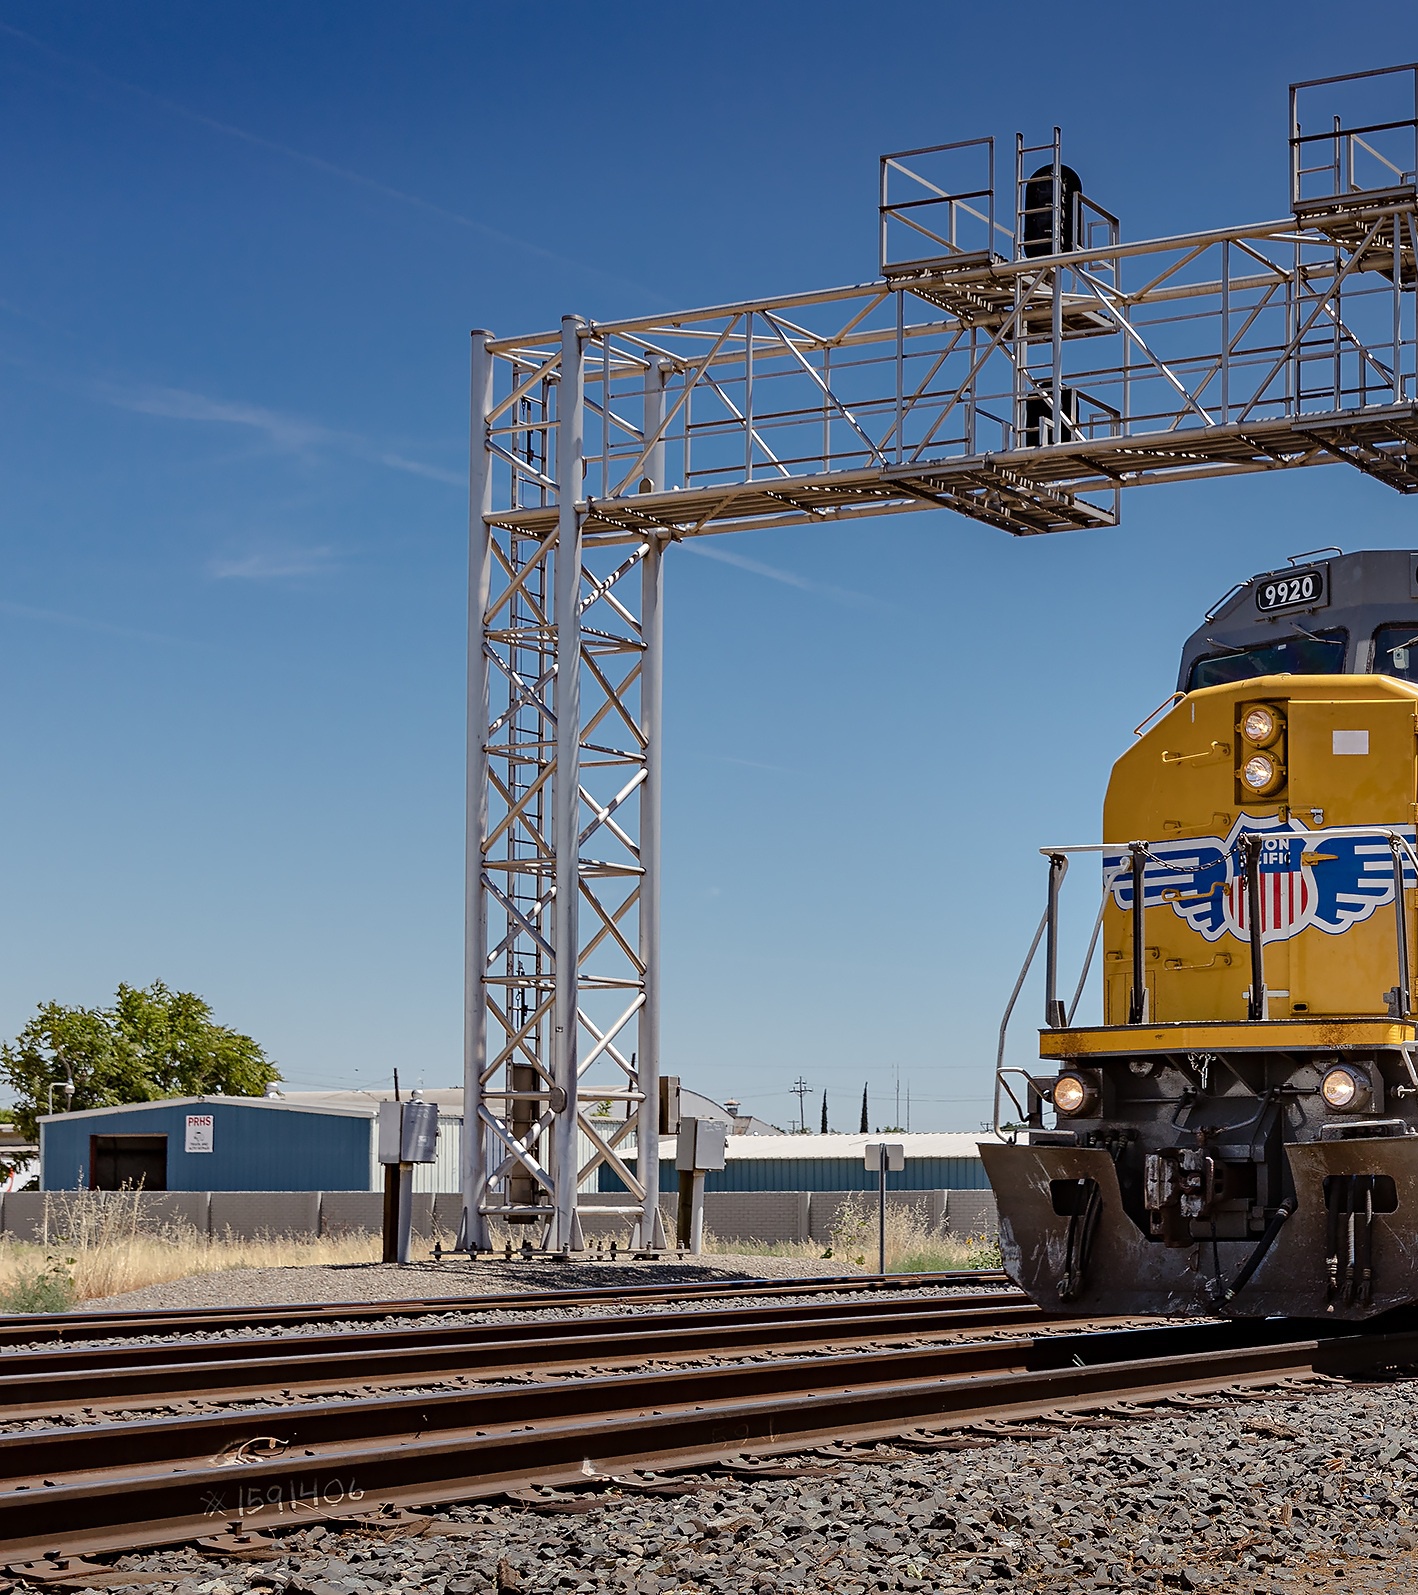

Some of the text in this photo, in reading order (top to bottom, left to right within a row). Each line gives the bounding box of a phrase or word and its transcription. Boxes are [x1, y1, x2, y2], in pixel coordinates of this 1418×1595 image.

[1265, 577, 1313, 606] 9920
[188, 1116, 211, 1127] PRHS
[239, 1477, 366, 1519] 1591406
